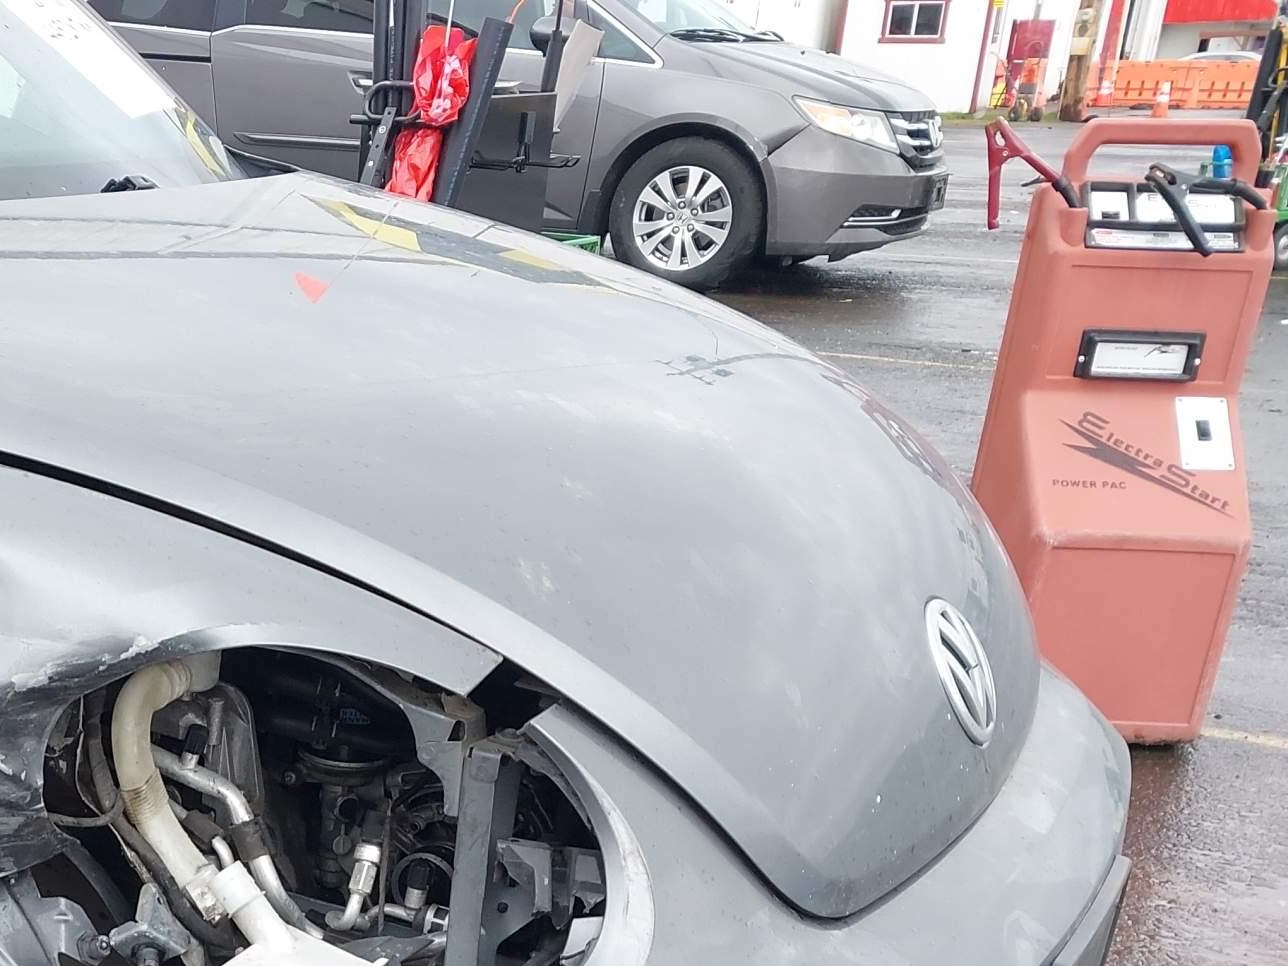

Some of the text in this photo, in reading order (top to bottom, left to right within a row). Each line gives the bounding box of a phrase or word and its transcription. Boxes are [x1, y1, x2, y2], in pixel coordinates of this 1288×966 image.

[1052, 478, 1128, 490] POWER PAC
[1077, 411, 1232, 511] Electra Start
